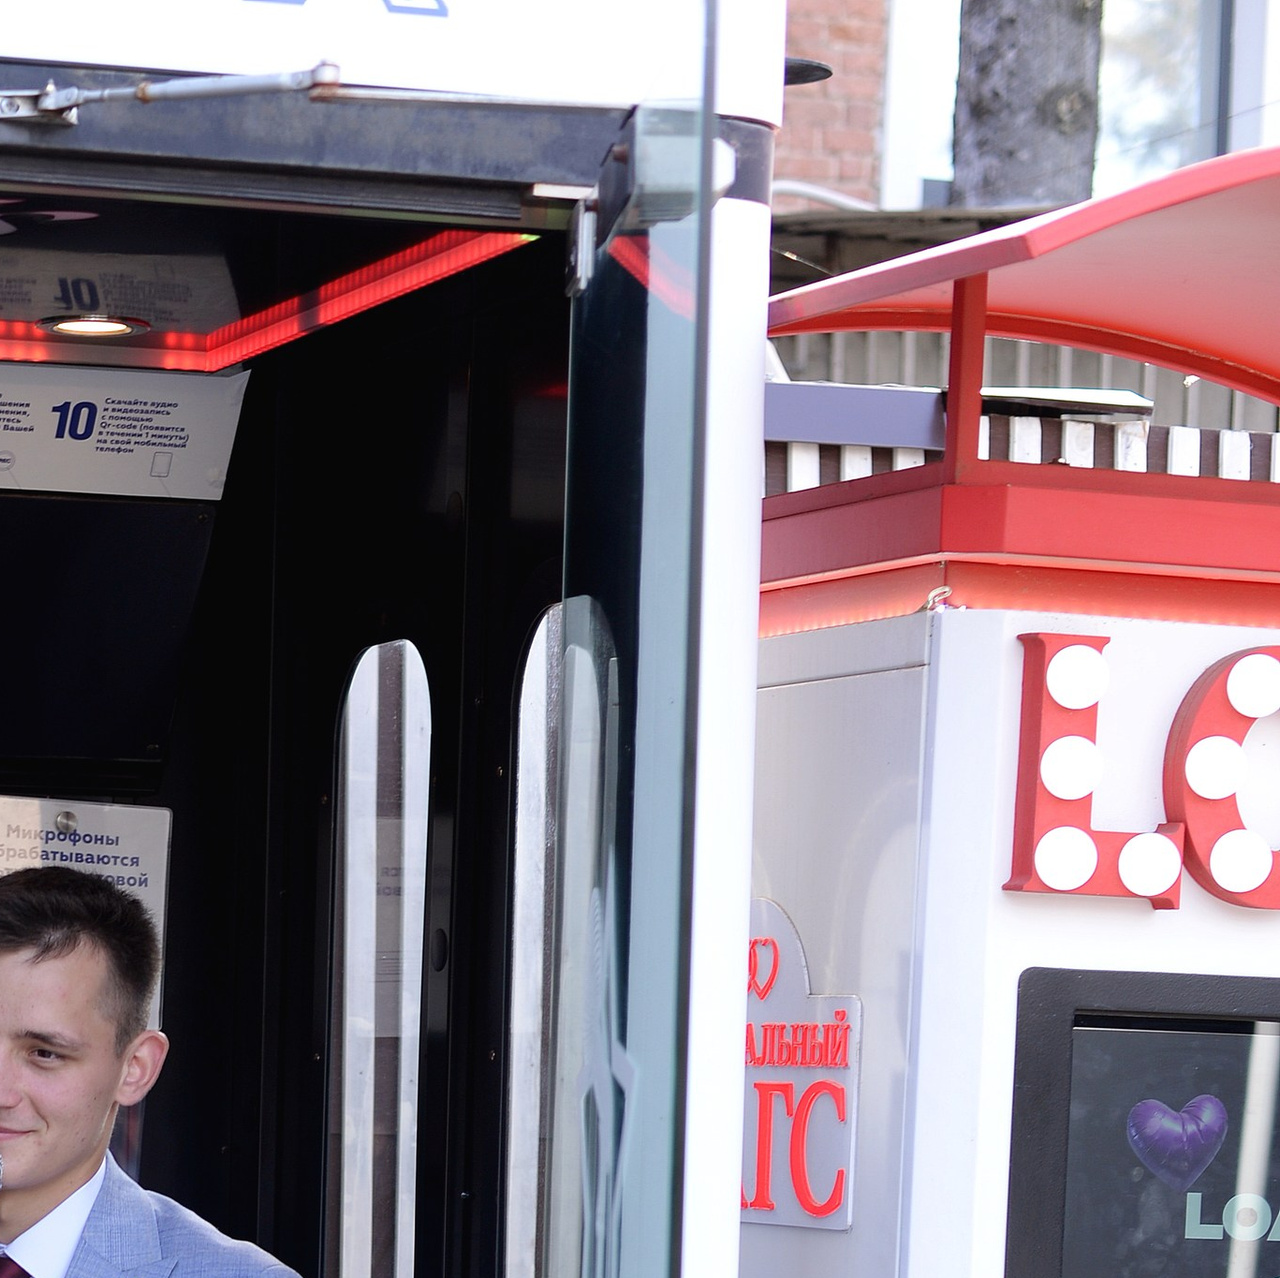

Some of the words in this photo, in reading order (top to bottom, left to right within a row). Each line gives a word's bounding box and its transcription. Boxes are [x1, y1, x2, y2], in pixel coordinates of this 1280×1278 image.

[104, 397, 148, 407] Скачайте
[150, 401, 179, 409] аудио
[111, 407, 171, 416] видеозапись
[51, 401, 98, 441] 10
[108, 415, 153, 423] помощью
[2, 424, 35, 432] Вашей
[95, 446, 134, 454] телефон
[133, 440, 187, 448] мобильный
[6, 824, 120, 846] Микрофоны
[745, 1009, 851, 1067] АЛЬНЫЙ
[741, 1079, 846, 1218] ГС
[1185, 1192, 1280, 1241] LO
